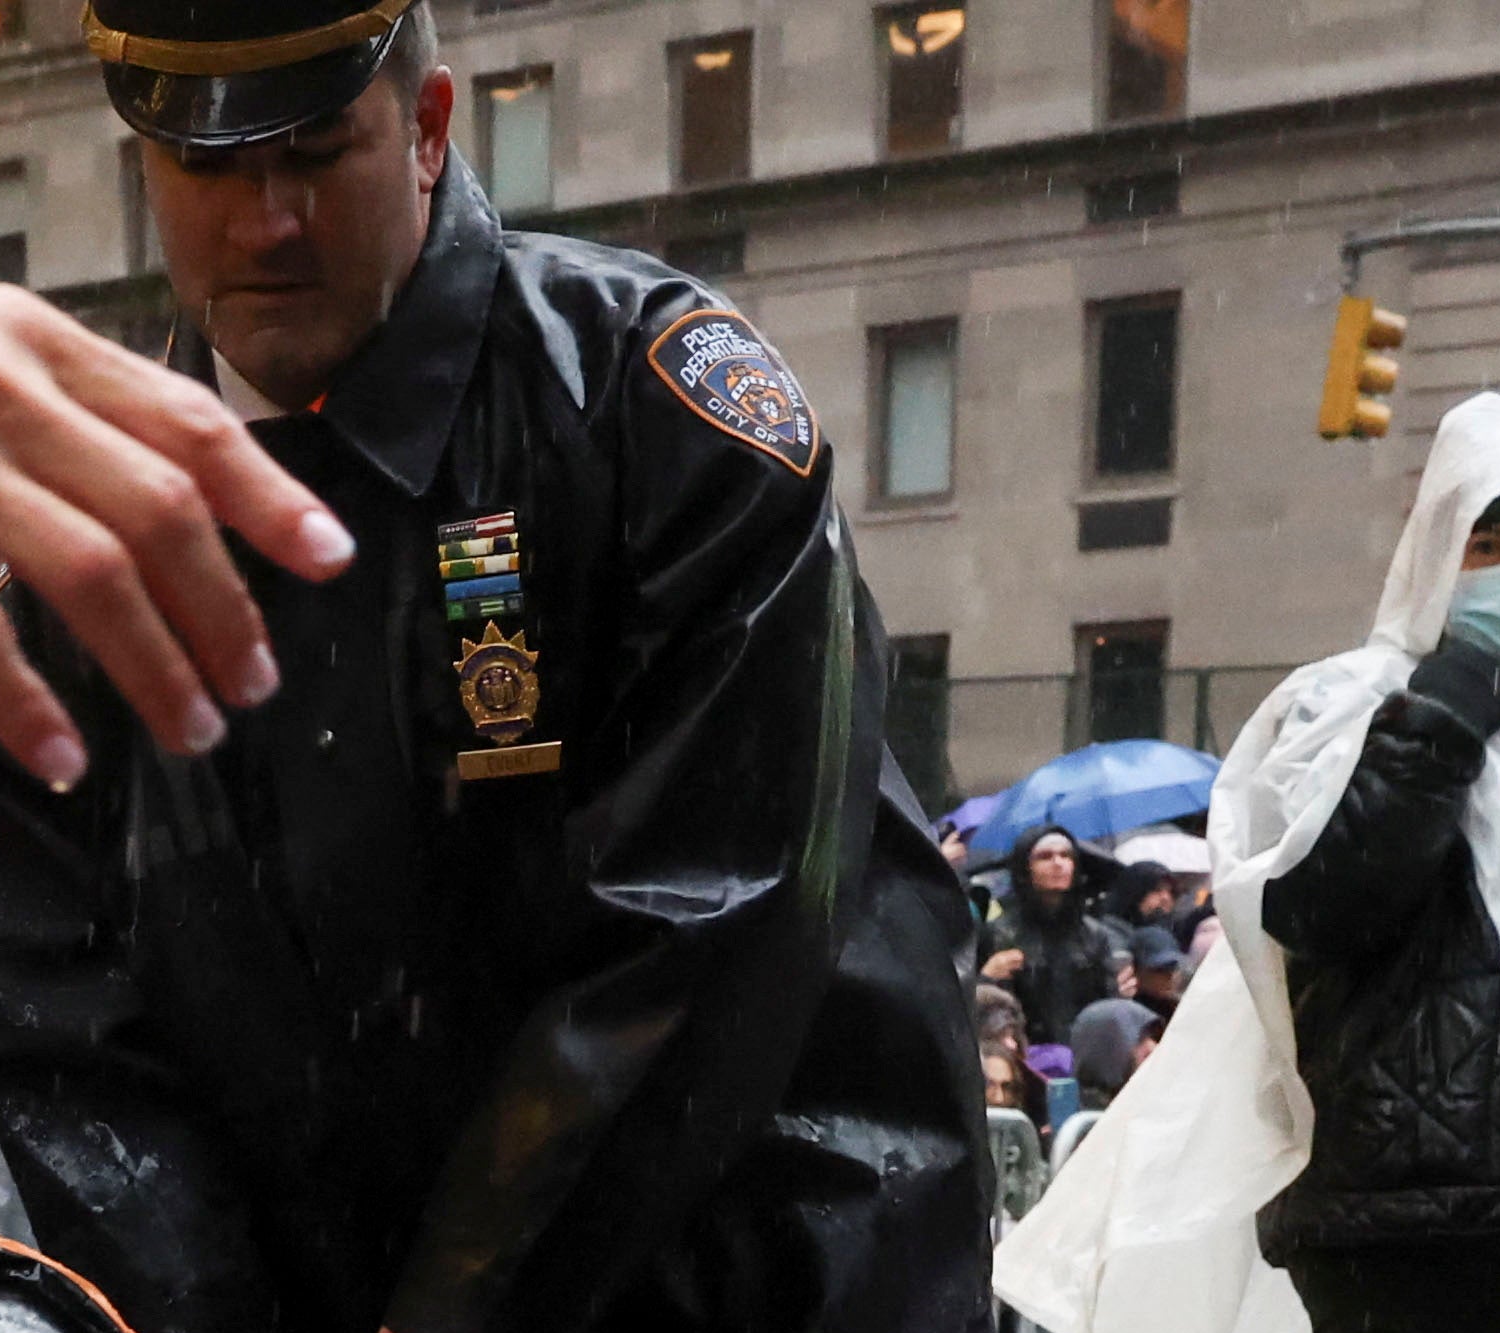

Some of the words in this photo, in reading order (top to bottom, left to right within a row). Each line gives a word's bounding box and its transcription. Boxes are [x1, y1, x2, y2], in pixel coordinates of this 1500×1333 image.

[681, 322, 740, 354] POLICE
[679, 338, 767, 389] DEPARTMENT
[707, 397, 749, 428] CITY
[754, 426, 779, 444] OF
[796, 413, 810, 446] NEW
